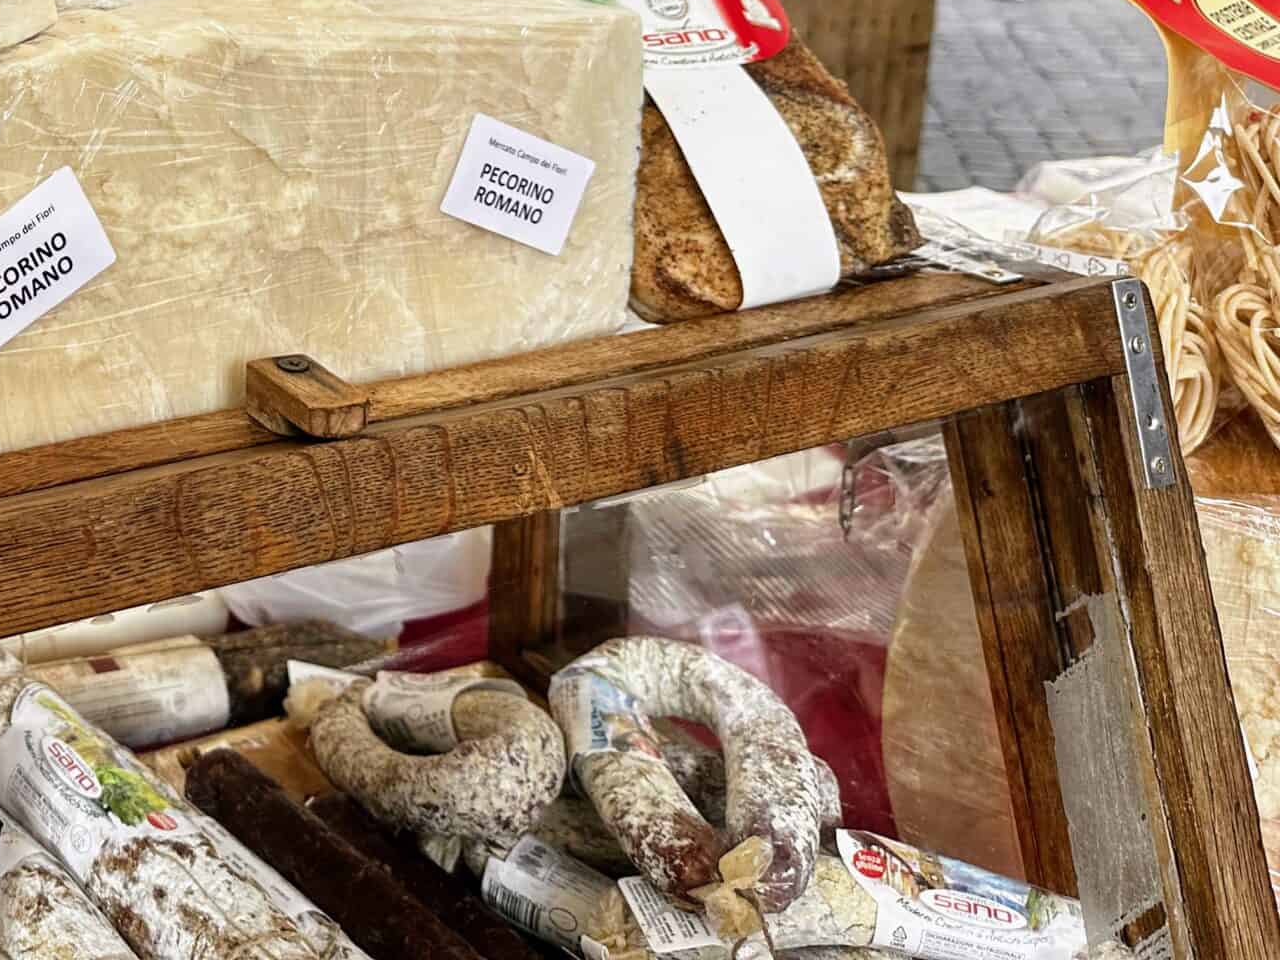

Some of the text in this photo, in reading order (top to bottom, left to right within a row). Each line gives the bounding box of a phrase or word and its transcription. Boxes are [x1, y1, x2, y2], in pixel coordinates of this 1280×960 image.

[642, 28, 725, 47] sano
[480, 163, 555, 205] PECORINO
[22, 219, 36, 235] dei
[35, 204, 56, 224] Fiori
[474, 186, 543, 224] ROMANO
[933, 894, 1013, 924] sano
